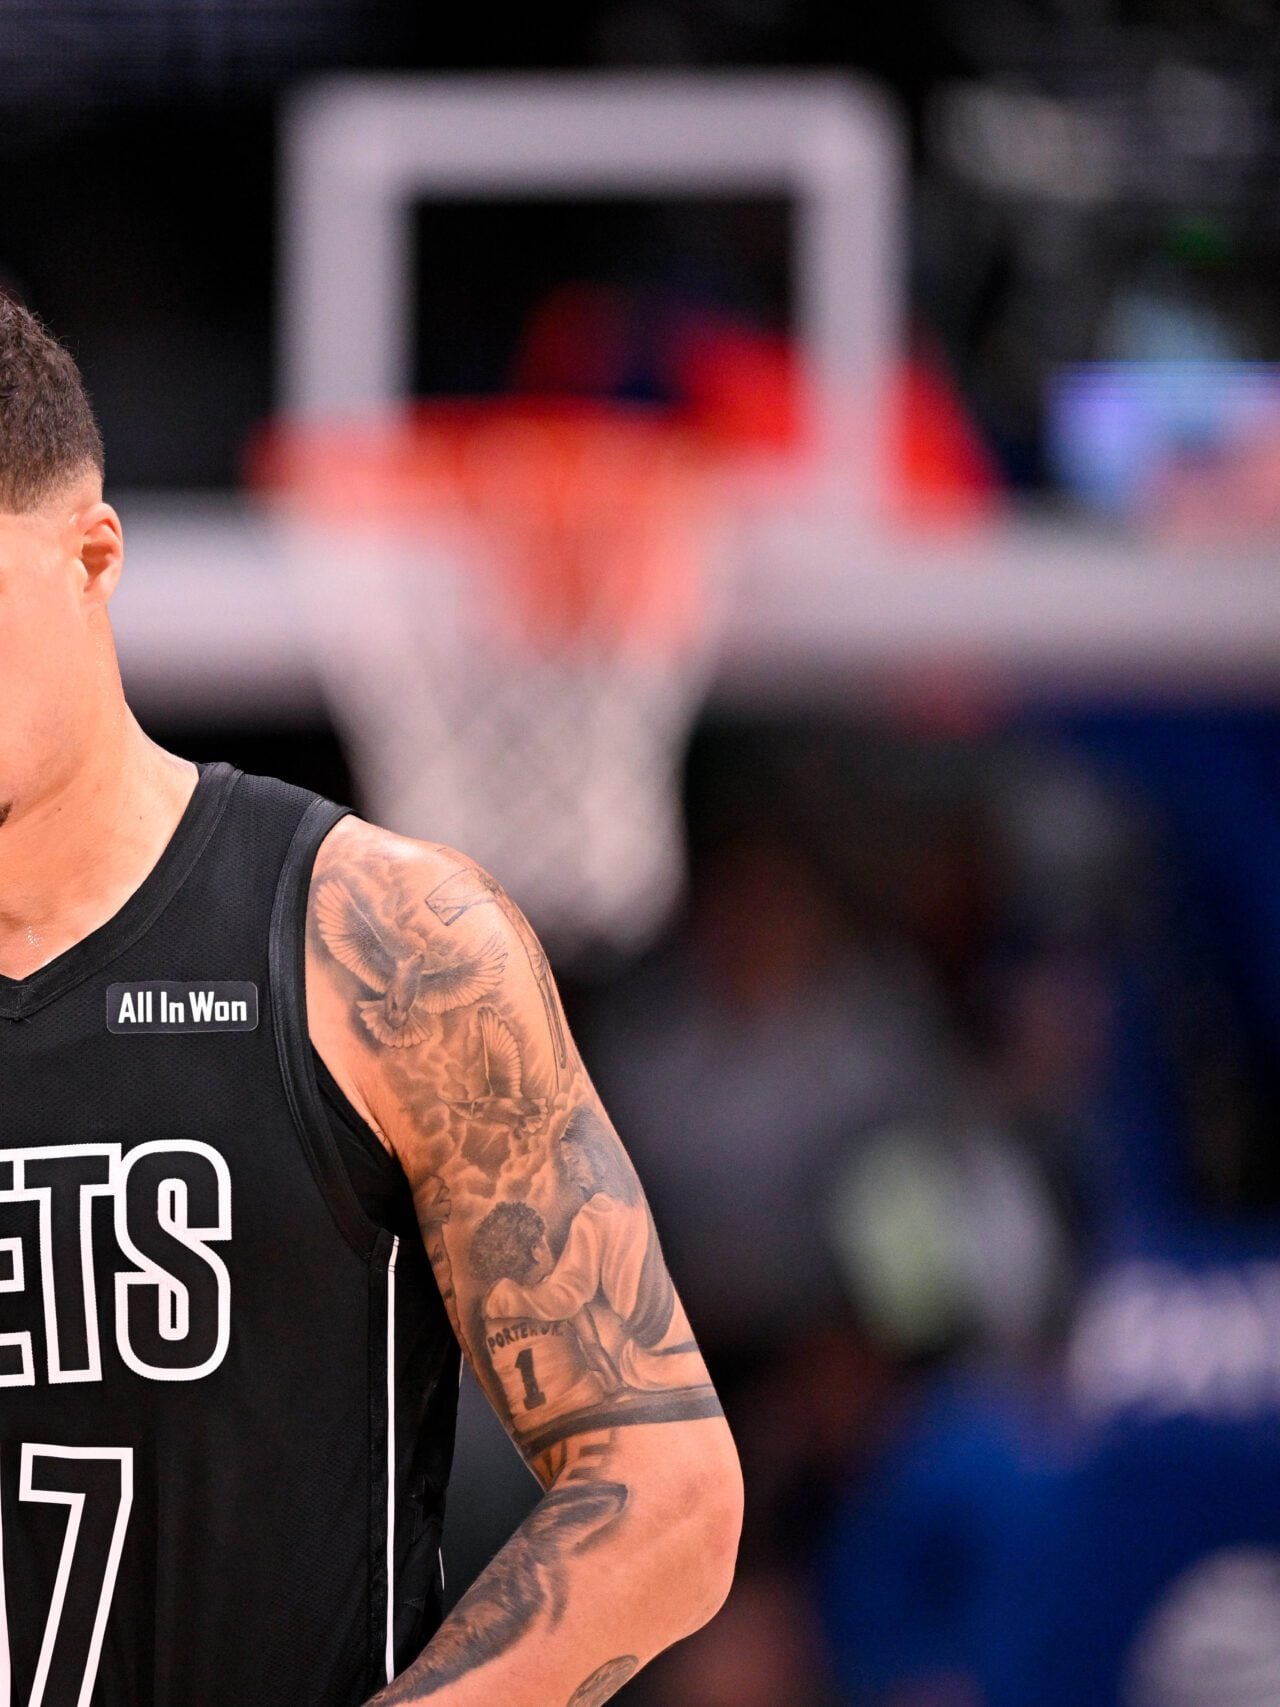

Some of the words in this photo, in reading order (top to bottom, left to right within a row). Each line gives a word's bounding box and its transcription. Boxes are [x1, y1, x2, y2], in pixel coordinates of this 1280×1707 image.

[118, 991, 153, 1024] All
[160, 991, 185, 1024] In
[188, 991, 248, 1023] Won
[514, 1348, 547, 1410] 1
